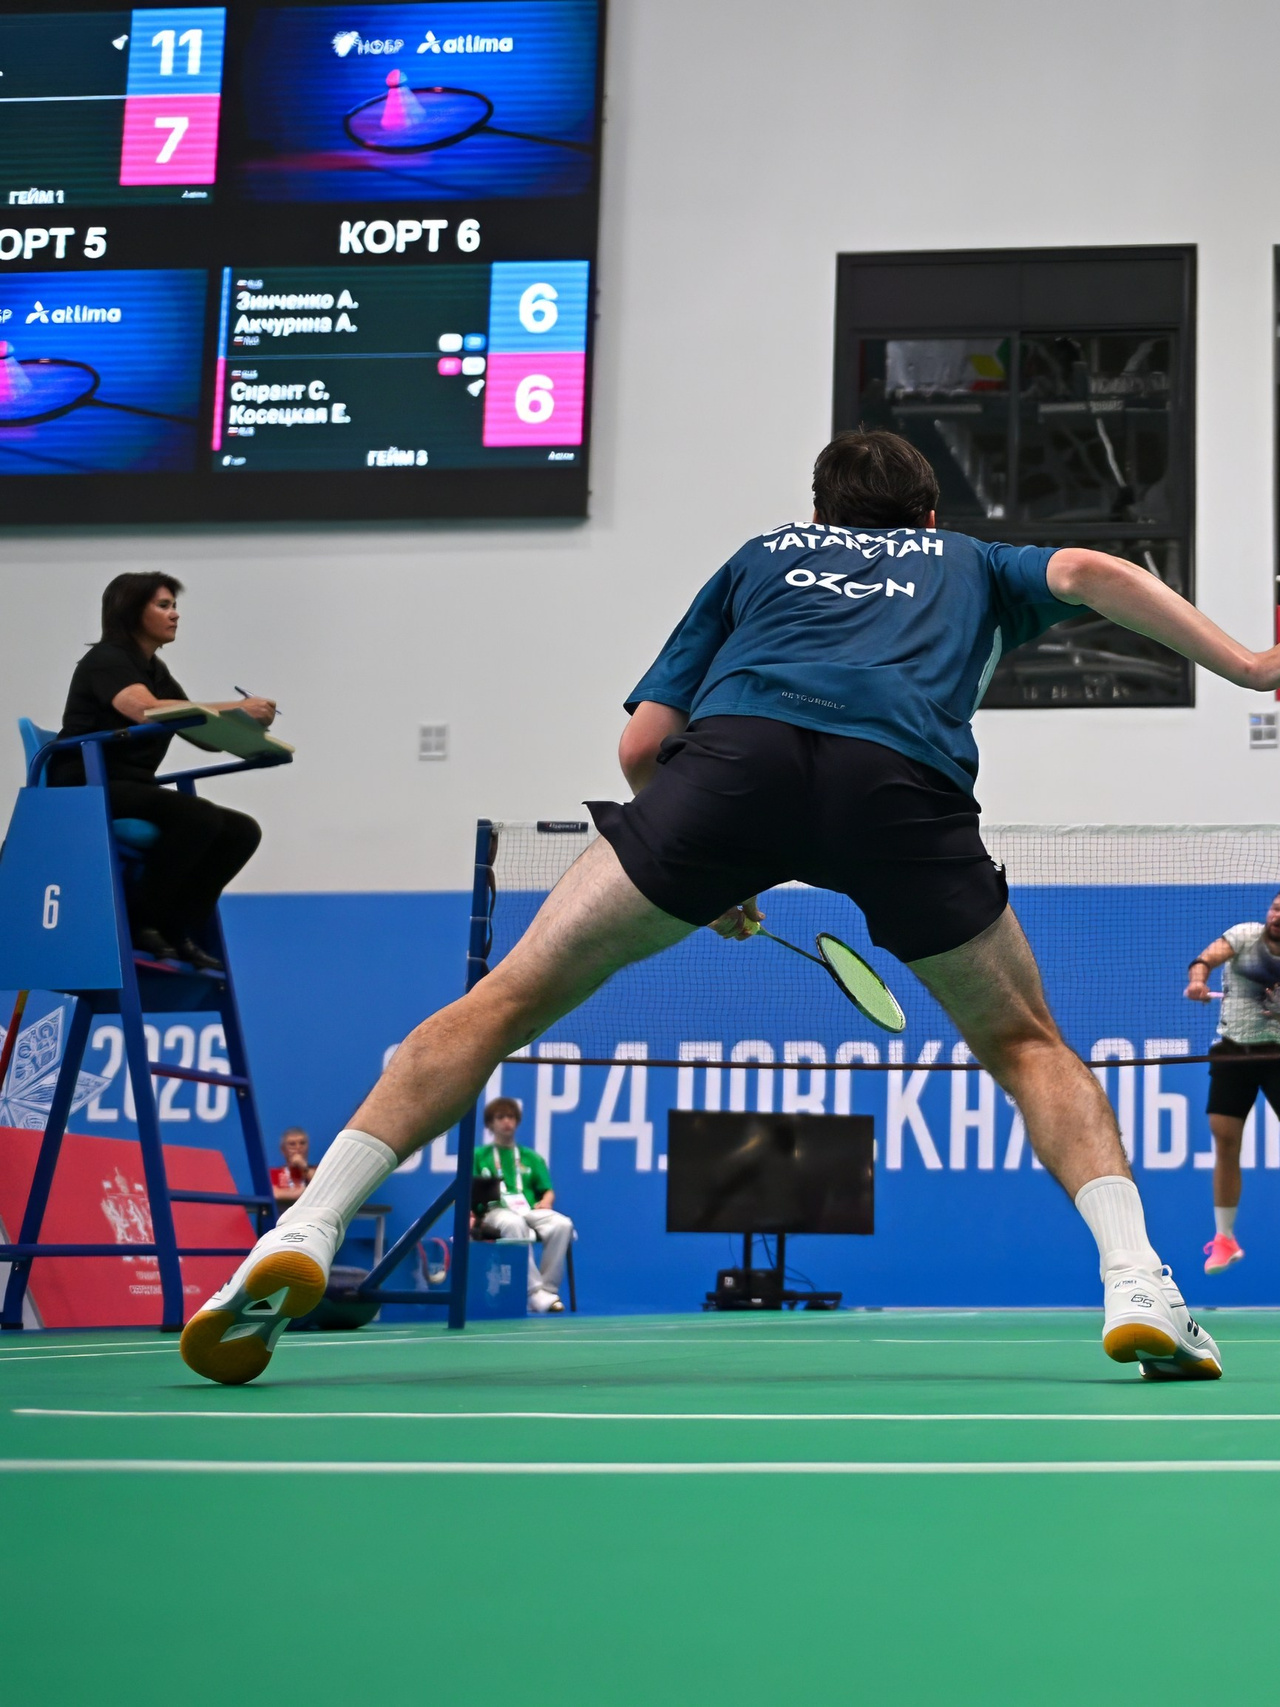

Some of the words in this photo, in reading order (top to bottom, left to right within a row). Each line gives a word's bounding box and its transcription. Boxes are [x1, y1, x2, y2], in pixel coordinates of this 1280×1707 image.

[151, 29, 203, 75] 11
[154, 117, 189, 163] 7
[8, 187, 54, 204] ГЕЙМ
[55, 189, 65, 204] 1
[83, 226, 107, 259] 5
[338, 219, 449, 255] КОРТ
[456, 218, 481, 251] 6
[336, 289, 359, 310] А.
[518, 283, 559, 333] 6
[335, 312, 358, 333] А.
[308, 380, 330, 401] С.
[515, 374, 555, 424] 6
[366, 446, 415, 467] ГЕЙМ
[785, 568, 915, 599] OZON
[43, 884, 61, 929] 6
[86, 1023, 232, 1123] 2026
